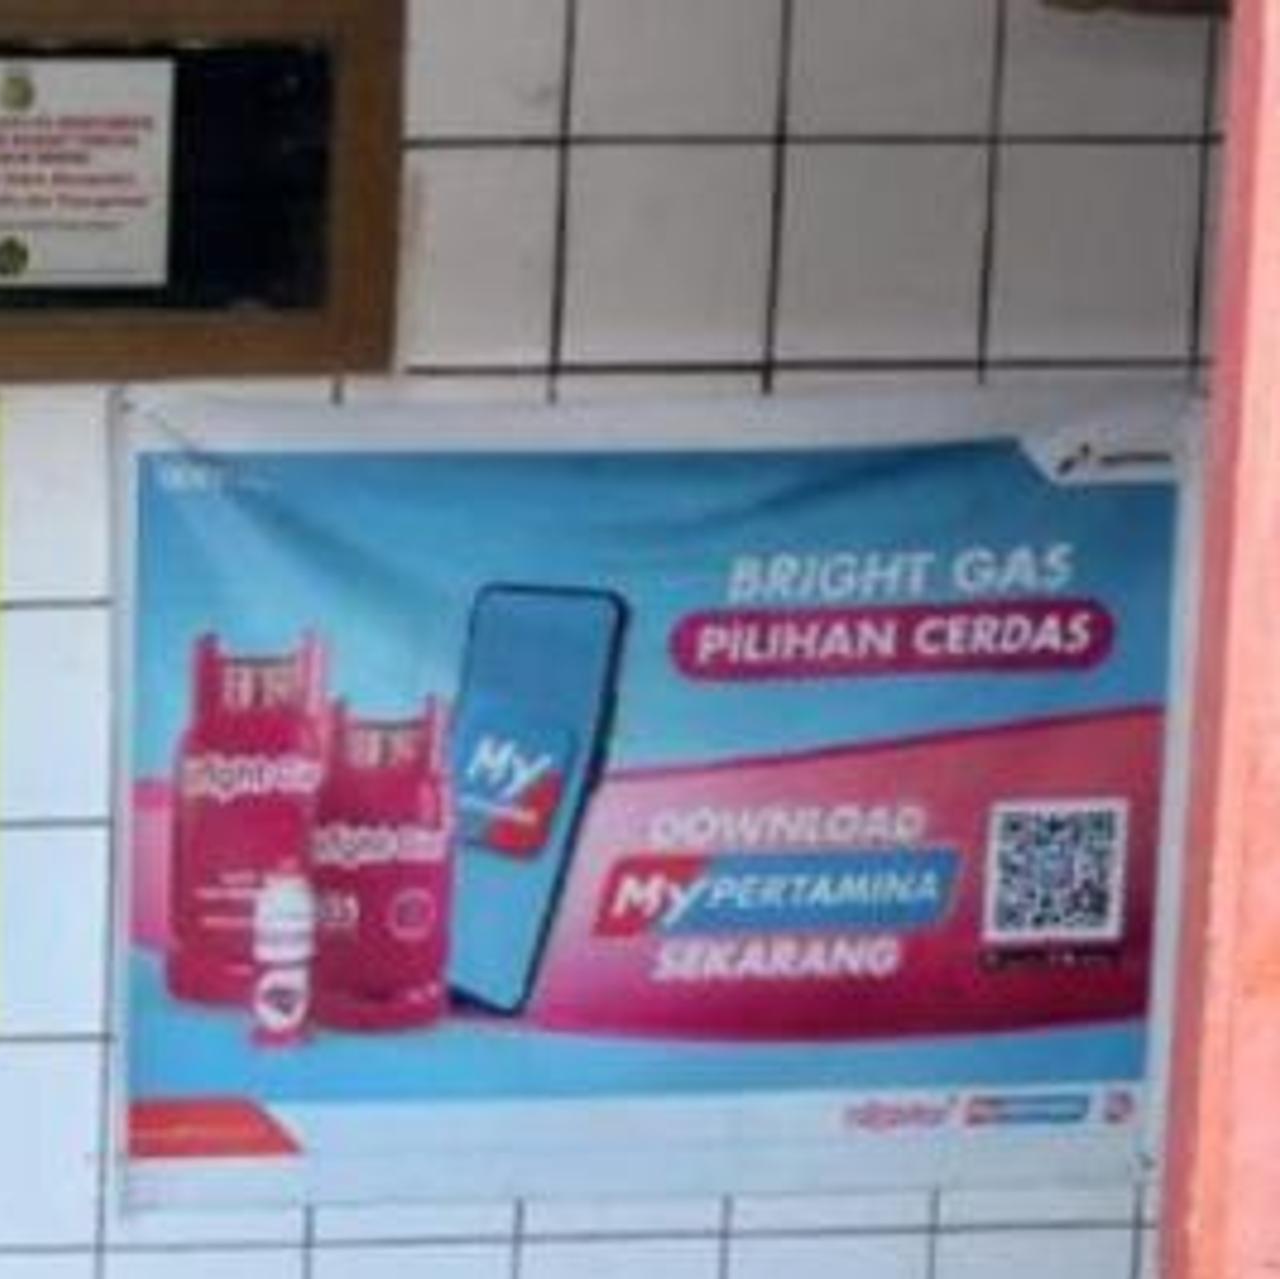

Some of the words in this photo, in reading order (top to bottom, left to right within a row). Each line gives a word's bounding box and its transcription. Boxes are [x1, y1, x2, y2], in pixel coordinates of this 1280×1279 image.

[727, 550, 935, 603] BRIGHT
[953, 543, 1076, 596] GAS
[696, 619, 897, 665] PILIHAN
[913, 612, 1092, 656] CERDAS
[467, 736, 552, 797] My
[652, 804, 929, 848] DOWNLOAD
[652, 938, 902, 982] SEKARANG
